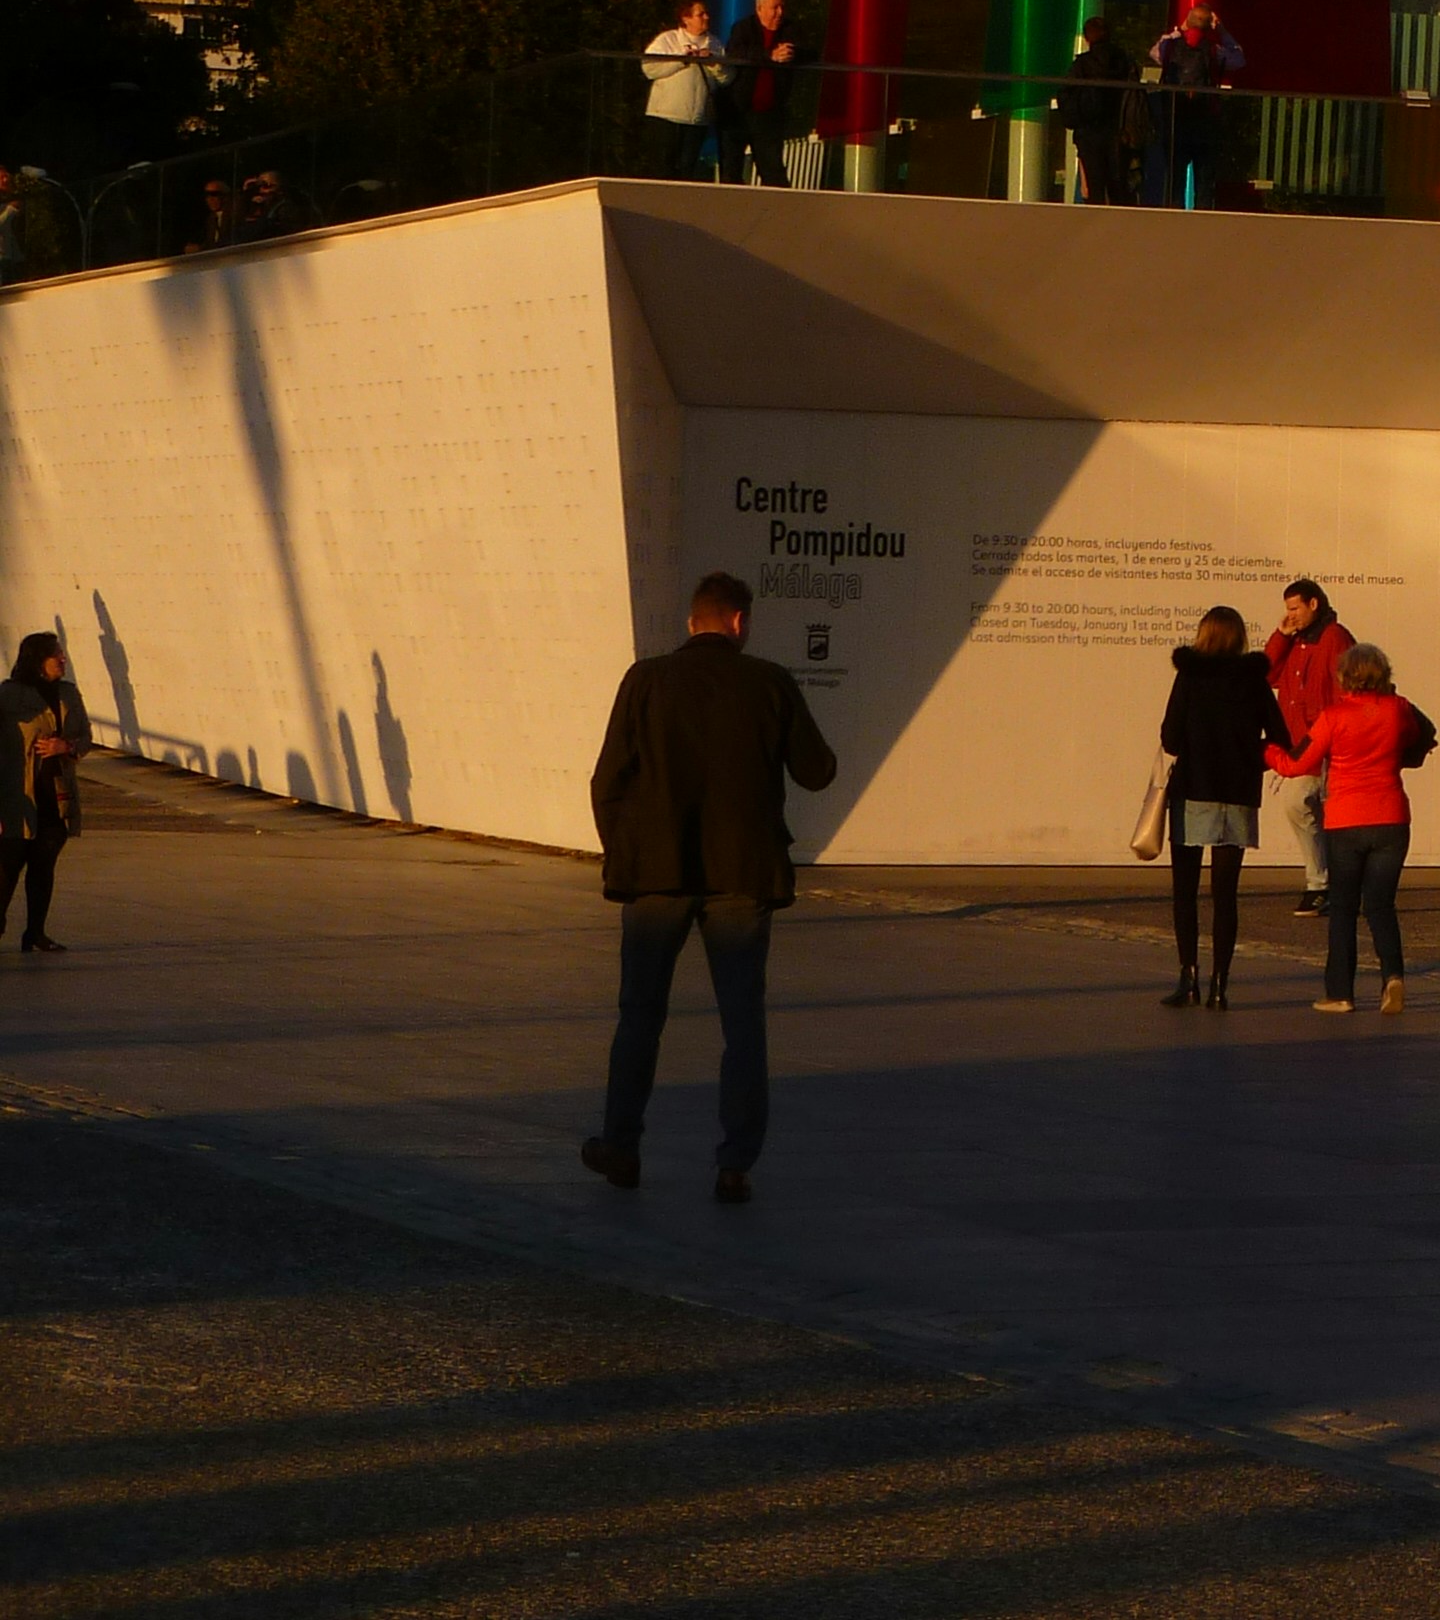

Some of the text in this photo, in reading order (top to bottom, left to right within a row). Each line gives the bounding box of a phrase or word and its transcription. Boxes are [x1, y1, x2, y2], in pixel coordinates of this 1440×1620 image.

[736, 477, 828, 514] Centre
[770, 520, 906, 566] Pompidou
[973, 534, 989, 546] De
[1067, 537, 1102, 550] horas,
[1105, 538, 1167, 552] incluyendo
[973, 550, 1018, 561] Cerrado
[1021, 551, 1054, 562] todos
[1056, 551, 1073, 563] los
[1076, 553, 1119, 566] martes,
[1132, 554, 1146, 565] de
[1149, 556, 1181, 566] enero
[1194, 555, 1209, 567] 25
[1212, 556, 1226, 567] de
[972, 564, 986, 576] Se
[988, 565, 1029, 577] admite
[1031, 566, 1043, 577] el
[1046, 567, 1085, 578] acceso
[1088, 566, 1102, 578] de
[1105, 567, 1158, 579] visitantes
[1161, 568, 1192, 580] hasta
[1195, 569, 1210, 581] 30
[1213, 570, 1258, 582] minutos
[1260, 572, 1292, 583] antes
[1315, 573, 1345, 584] cierre
[1347, 573, 1364, 585] del
[760, 563, 862, 608] Málaga
[971, 602, 1000, 613] From
[1032, 603, 1043, 614] to
[1082, 604, 1117, 617] hours,
[1120, 606, 1171, 619] including
[970, 616, 1009, 628] Closed
[1012, 619, 1026, 628] on
[1030, 617, 1080, 631] Tuesday,
[1083, 619, 1128, 633] January
[1151, 620, 1173, 631] and
[970, 632, 993, 643] Last
[996, 631, 1055, 643] admission
[1057, 632, 1089, 646] thirty
[1091, 634, 1137, 646] minutes
[1140, 634, 1176, 646] before
